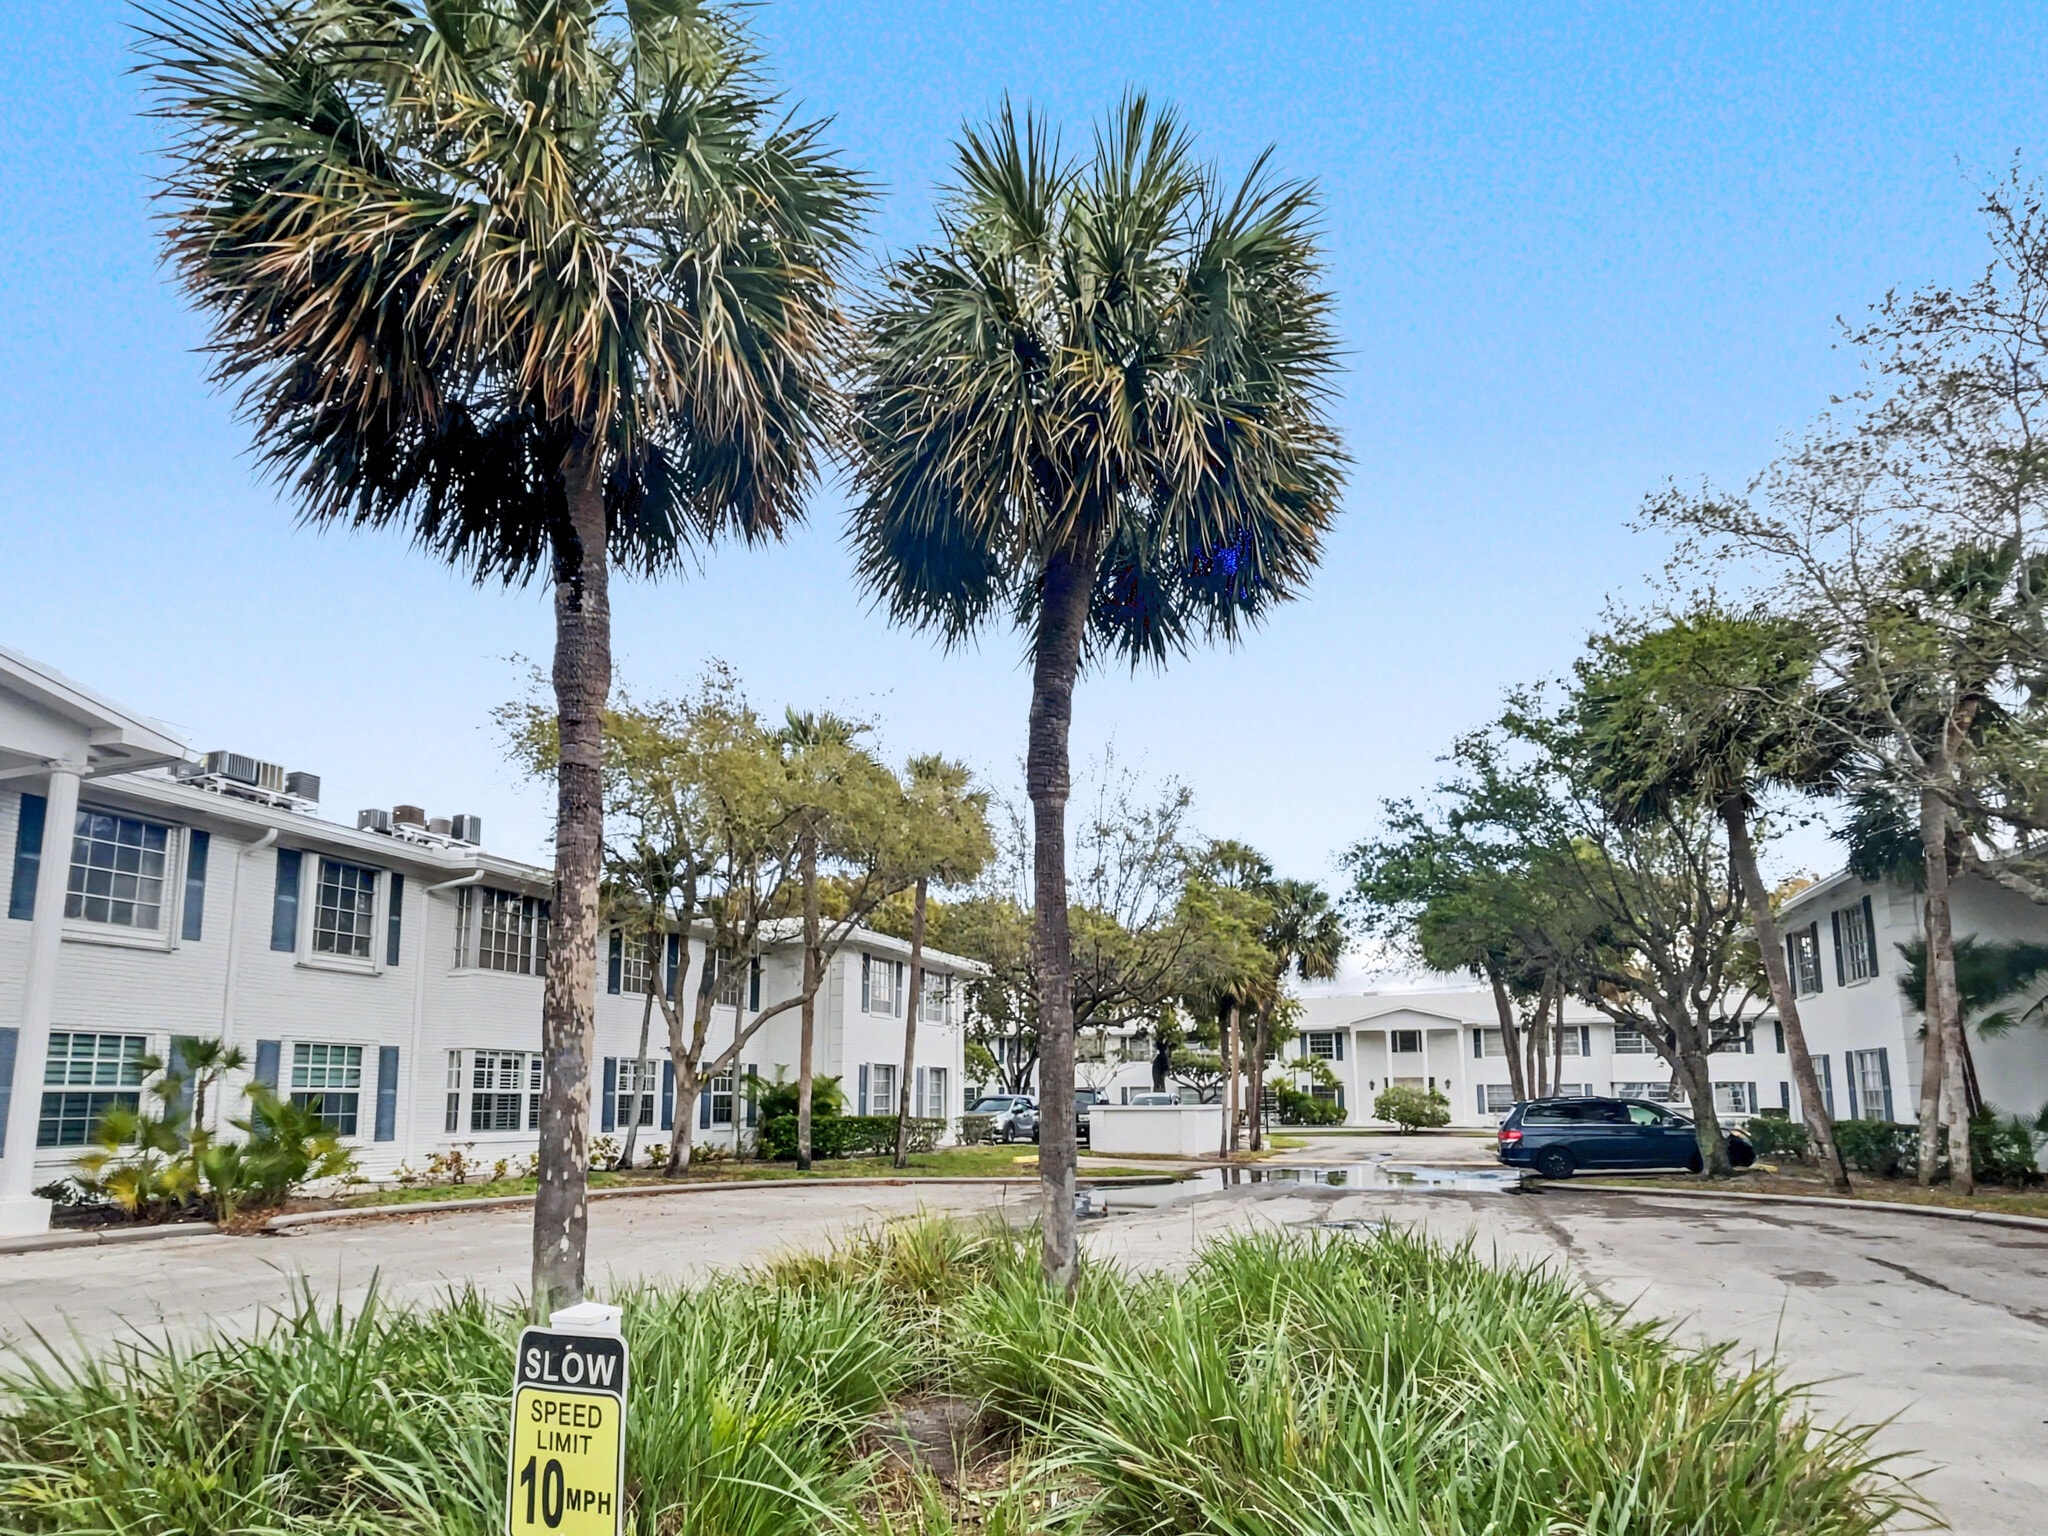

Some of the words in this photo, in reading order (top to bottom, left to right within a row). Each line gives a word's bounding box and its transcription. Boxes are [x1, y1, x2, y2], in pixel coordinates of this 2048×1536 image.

[525, 1348, 617, 1386] SLOW
[531, 1399, 602, 1429] SPEED
[537, 1430, 592, 1455] LIMIT
[520, 1455, 564, 1529] 10
[566, 1488, 611, 1515] MPH
